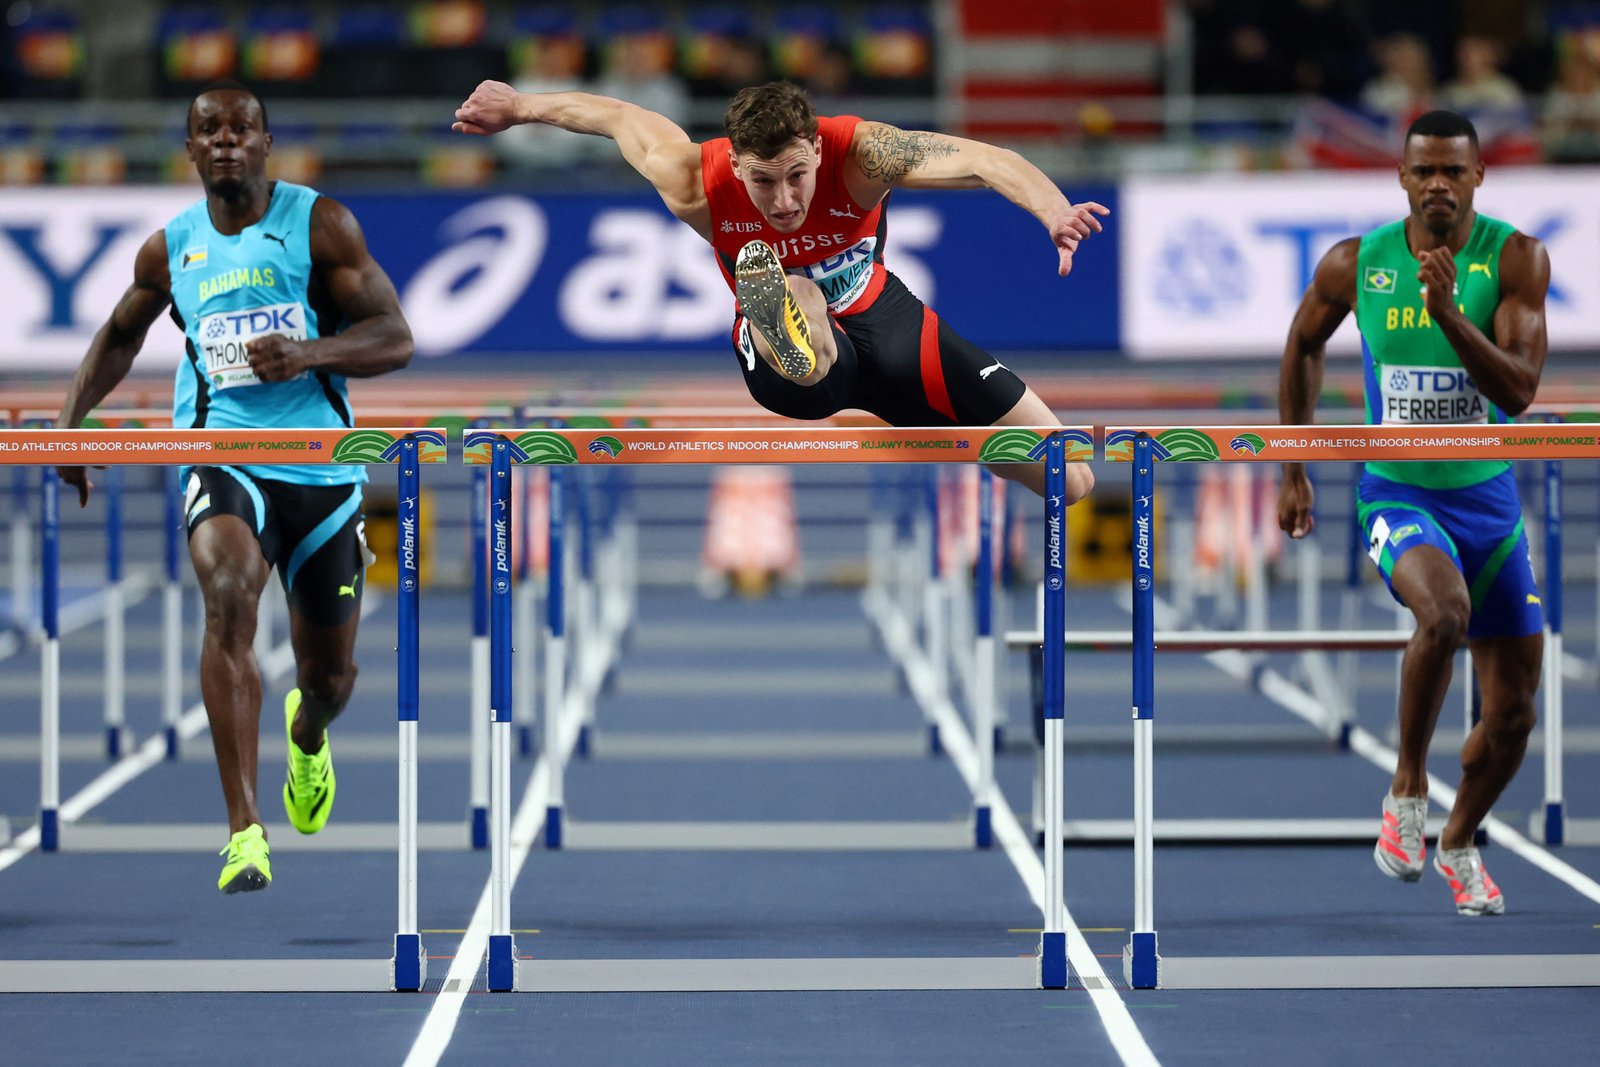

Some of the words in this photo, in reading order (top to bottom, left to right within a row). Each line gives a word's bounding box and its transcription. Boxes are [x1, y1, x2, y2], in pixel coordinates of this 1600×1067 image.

[735, 221, 763, 234] UBS
[199, 267, 275, 302] BAHAMAS
[819, 254, 870, 300] MMER
[226, 308, 297, 335] TDK
[1388, 396, 1483, 420] FERREIRA
[21, 442, 78, 451] ATHLETICS
[80, 442, 122, 451] INDOOR
[124, 441, 212, 451] CHAMPIONSHIPS
[214, 441, 256, 450] KUJAWY
[258, 441, 307, 450] POMORZE
[308, 441, 322, 450] 26
[627, 441, 666, 451] WORLD
[667, 441, 725, 451] ATHLETICS
[726, 441, 769, 451] INDOOR
[771, 440, 859, 450] CHAMPIONSHIPS
[861, 440, 903, 449] KUJAWY
[904, 440, 954, 449] POMORZE
[955, 440, 969, 449] 26
[1269, 439, 1308, 448] WORLD
[1309, 439, 1366, 448] ATHLETICS
[1369, 438, 1411, 448] INDOOR
[1413, 437, 1501, 447] CHAMPIONSHIPS
[1502, 437, 1545, 446] KUJAWY
[1546, 436, 1596, 446] POMORZE
[402, 517, 416, 571] polanik
[494, 519, 509, 573] polanik
[1048, 515, 1063, 569] polanik
[1136, 515, 1151, 569] polanik
